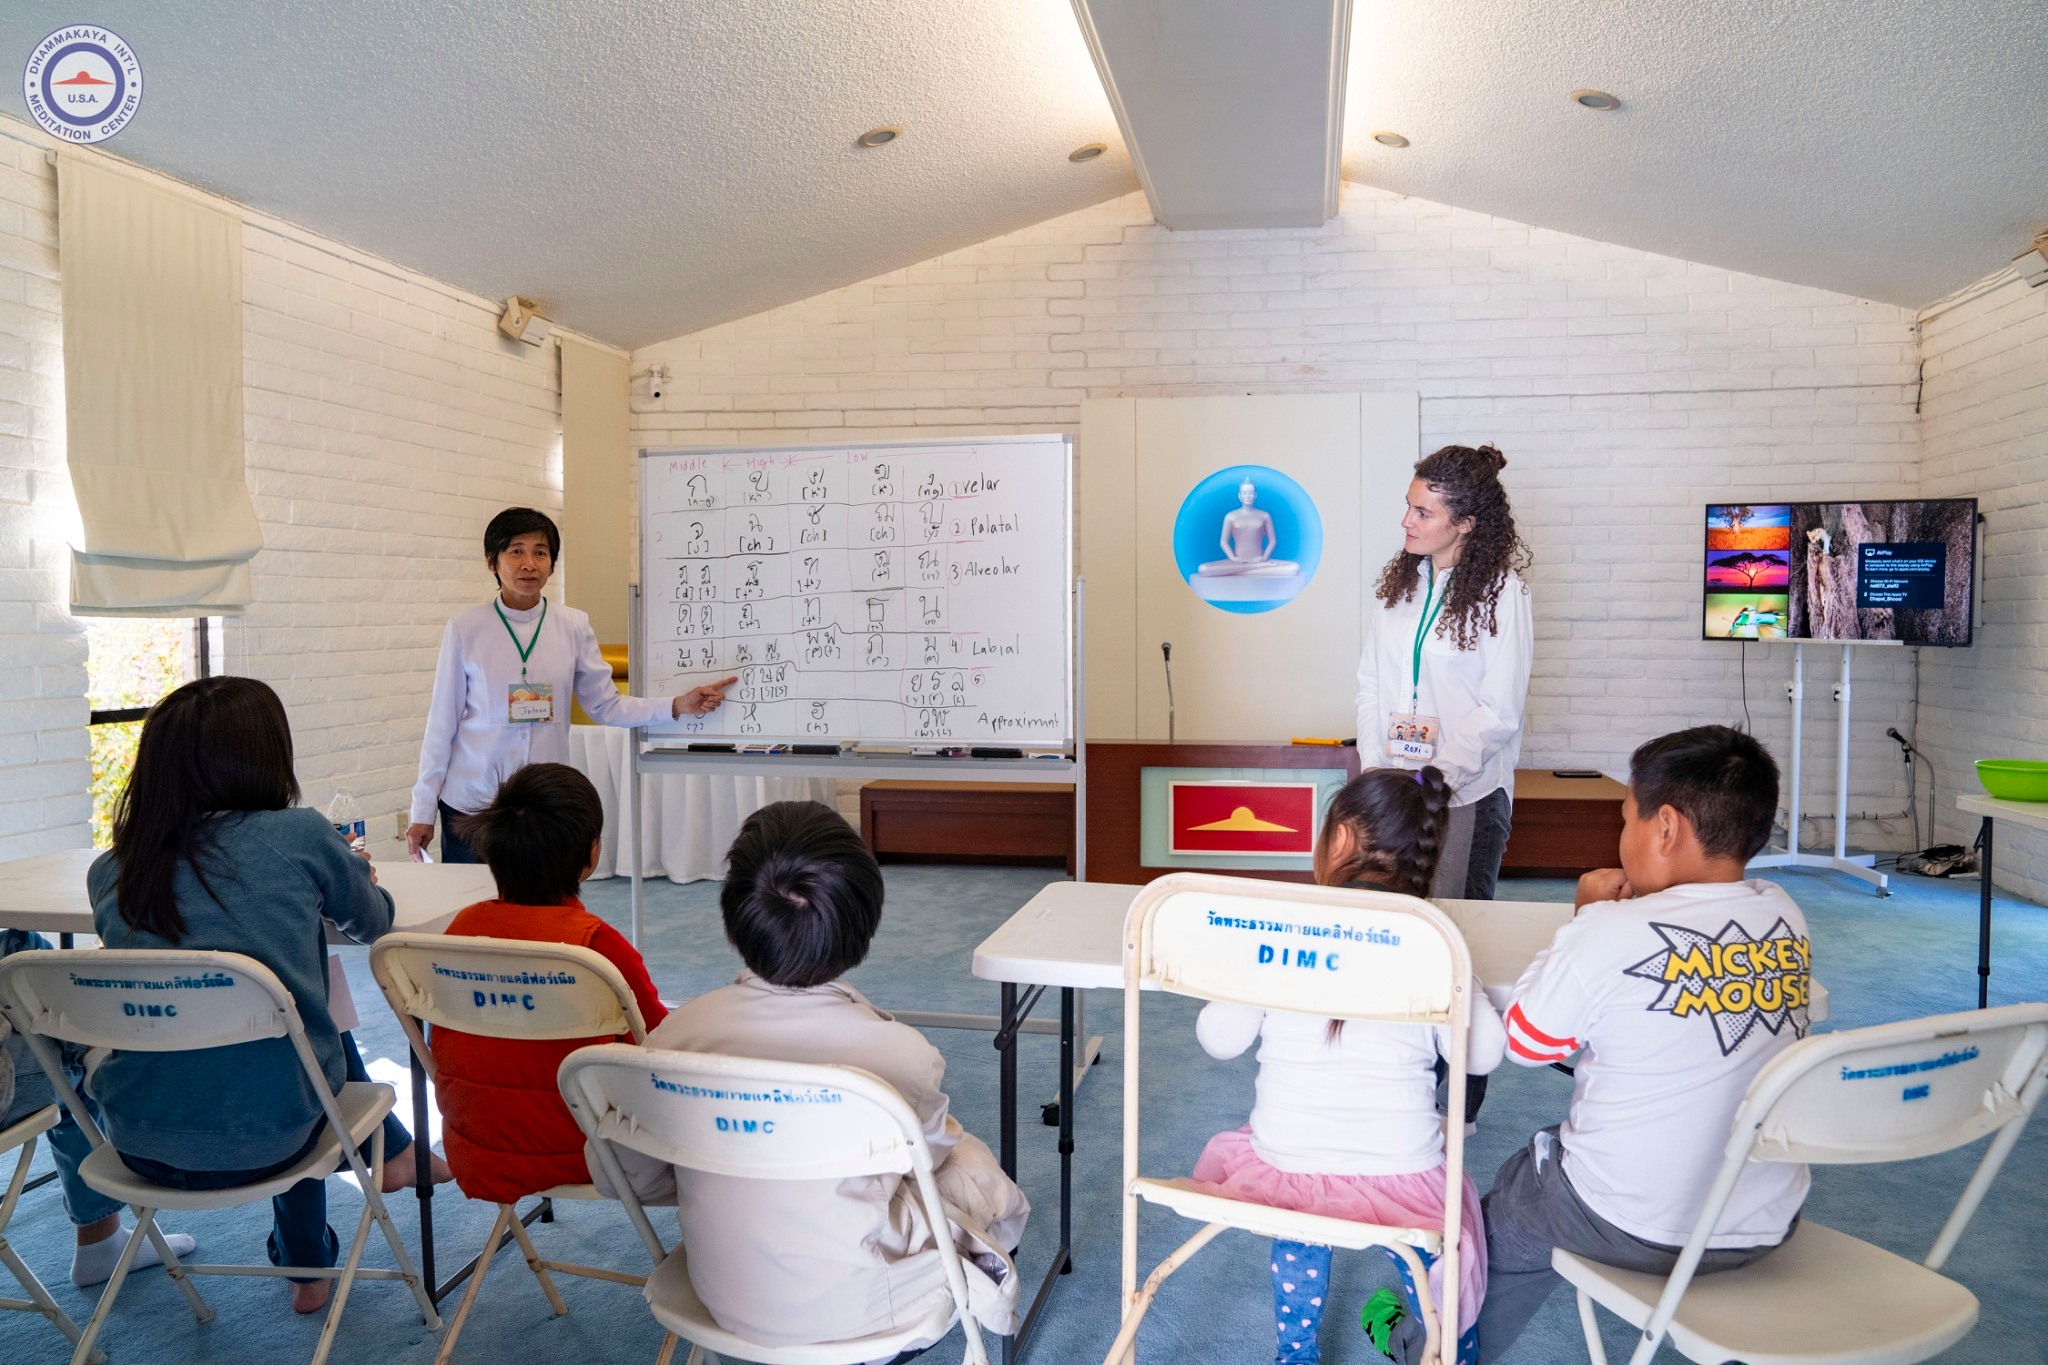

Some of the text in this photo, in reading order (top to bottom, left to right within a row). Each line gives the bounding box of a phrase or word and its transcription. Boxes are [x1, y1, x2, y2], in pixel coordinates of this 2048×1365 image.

[669, 457, 708, 474] Middle
[746, 455, 775, 470] High
[971, 513, 1019, 536] Palatal
[1404, 744, 1422, 754] Roxi
[1206, 910, 1400, 946] วัดพระธรรมกายแคลิฟอร์เนีย
[1258, 944, 1340, 971] DIMC
[1662, 935, 1811, 984] MICKEY
[432, 962, 576, 985] วัดพระธรรมกายแคลิฟอร์เนีย
[1670, 974, 1810, 1018] MOUSE
[123, 1003, 177, 1017] DIMC
[716, 1116, 776, 1134] DIMC
